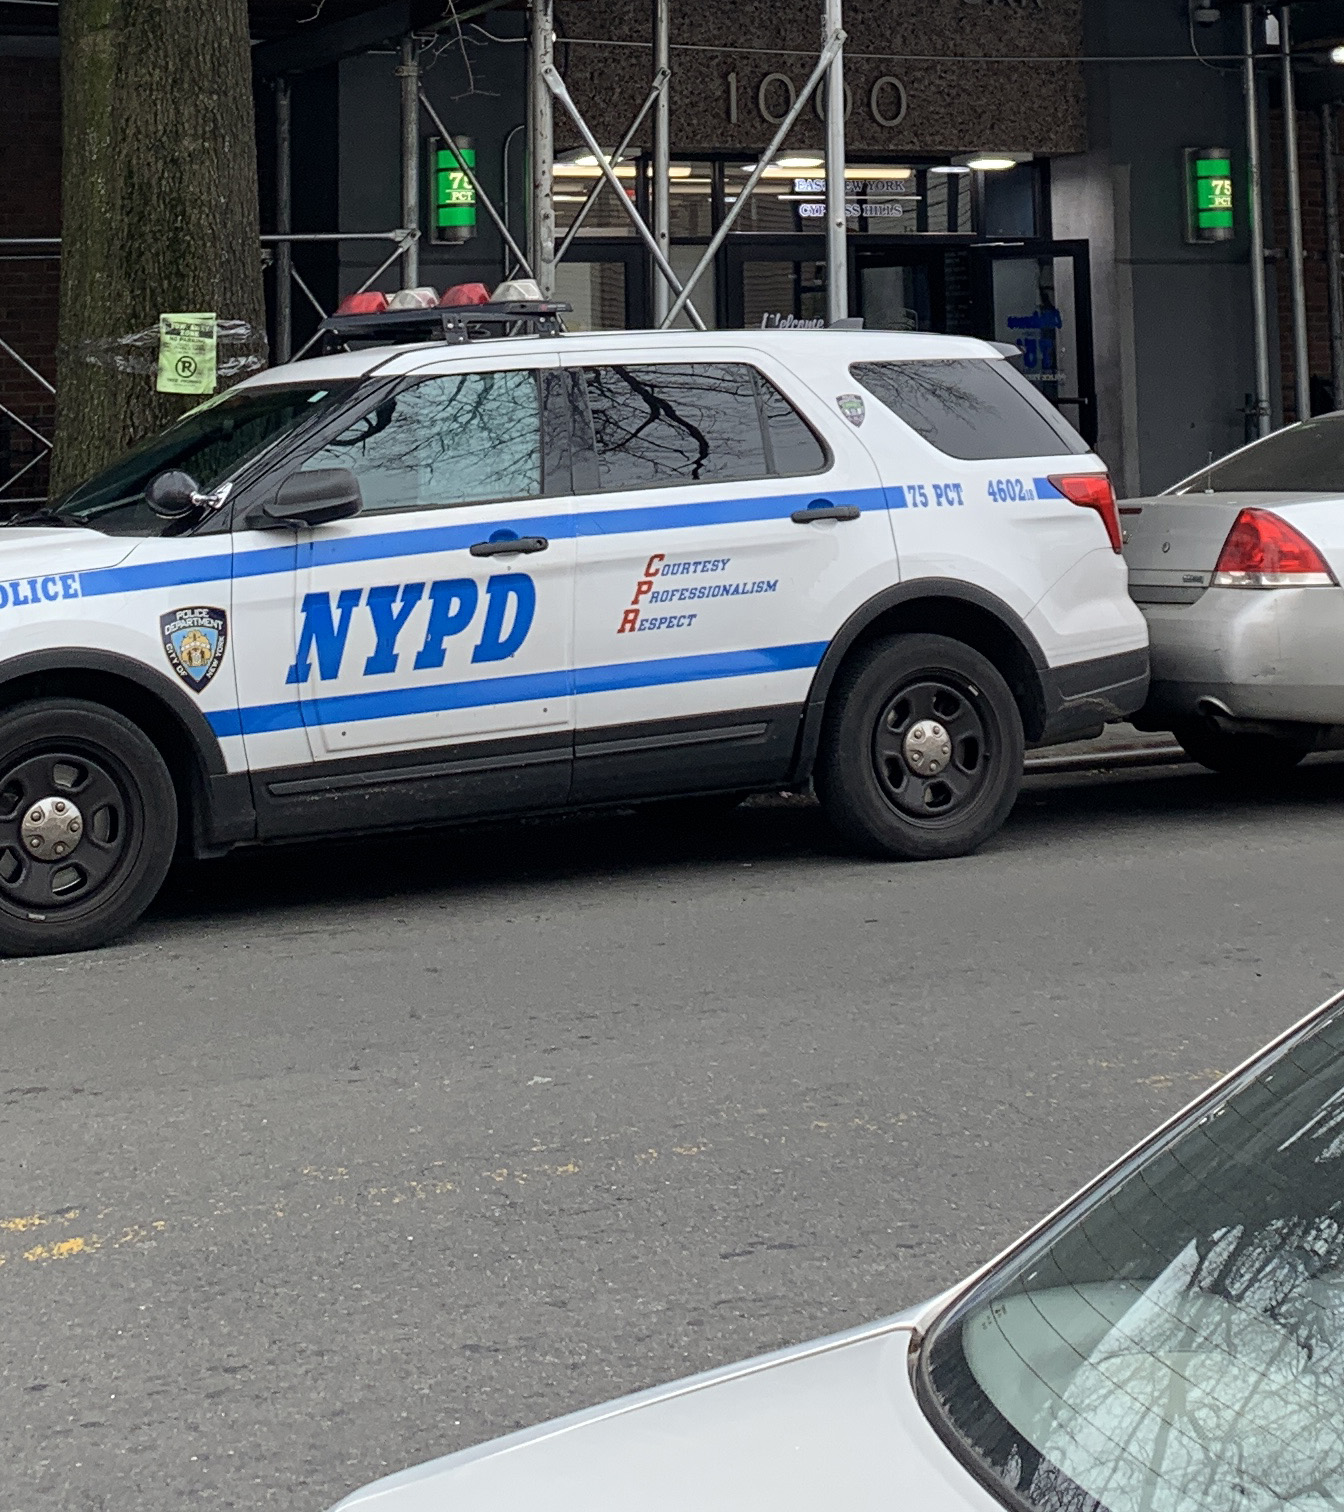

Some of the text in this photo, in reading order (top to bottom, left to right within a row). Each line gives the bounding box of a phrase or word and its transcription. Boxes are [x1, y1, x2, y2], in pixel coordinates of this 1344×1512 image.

[727, 72, 907, 127] 1000
[451, 191, 472, 201] PCT
[794, 178, 825, 193] EAS
[867, 180, 906, 193] YORK
[1211, 180, 1232, 195] 75
[799, 204, 903, 218] CYPSS HILLS
[907, 484, 929, 508] 75
[932, 482, 965, 507] PCT
[987, 478, 1026, 503] 4602
[643, 553, 731, 578] COURTESY
[630, 579, 779, 606] PROFESSIONALISM
[164, 617, 224, 635] DEPARTMENT
[176, 609, 210, 620] POLICE
[616, 608, 698, 634] RESPECT
[285, 572, 537, 685] NYPD
[165, 643, 188, 676] CITY OF
